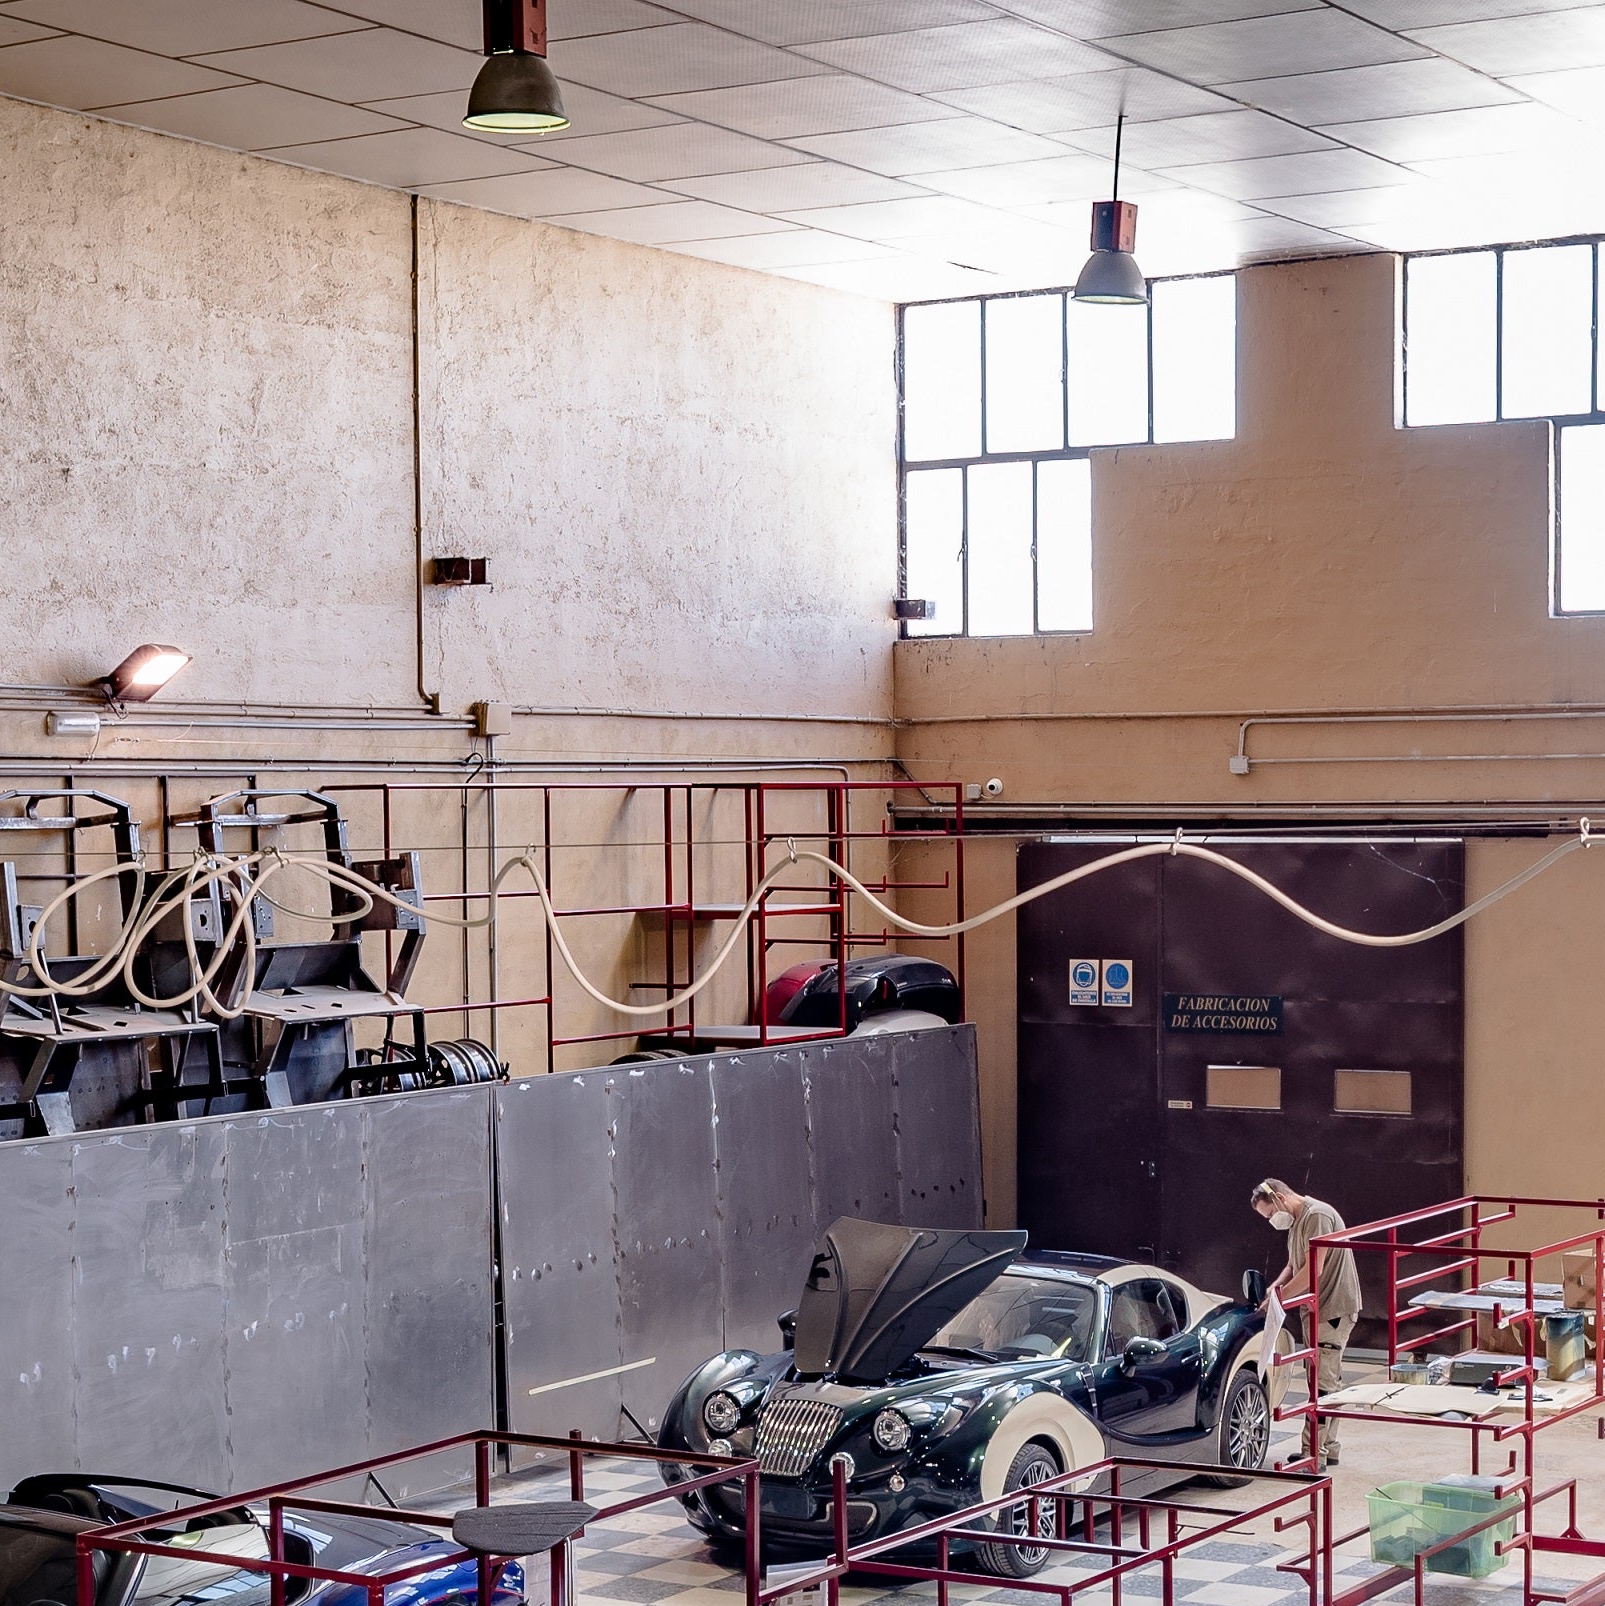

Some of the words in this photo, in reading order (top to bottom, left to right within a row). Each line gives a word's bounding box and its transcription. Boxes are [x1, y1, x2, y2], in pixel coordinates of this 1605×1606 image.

[1178, 997, 1271, 1012] FABRICACION
[1171, 1014, 1191, 1028] DE
[1192, 1015, 1278, 1030] ACCESORIOS
